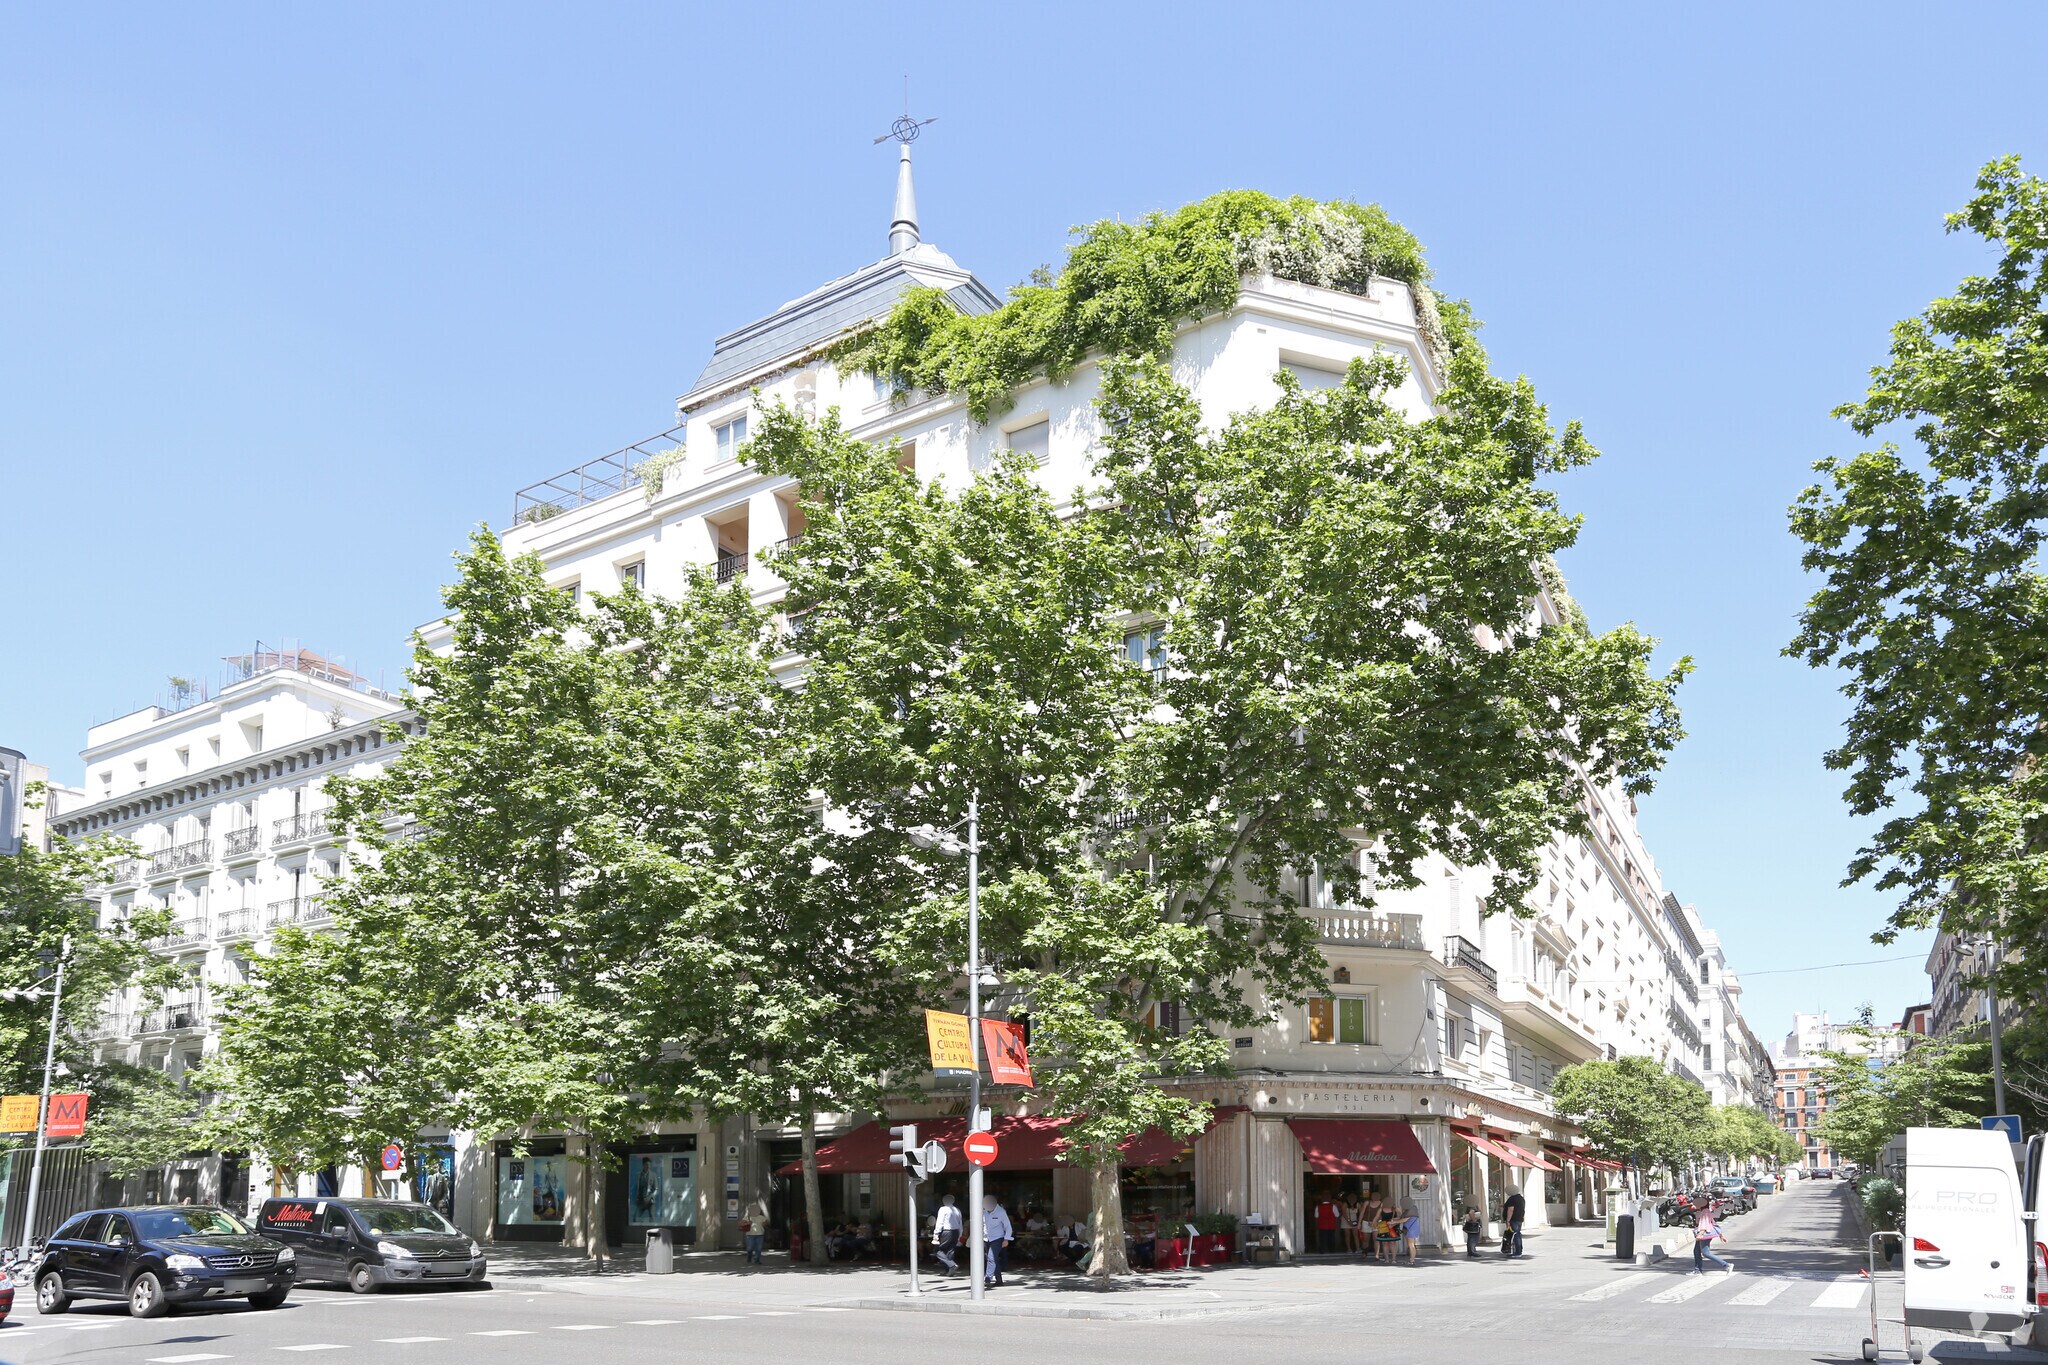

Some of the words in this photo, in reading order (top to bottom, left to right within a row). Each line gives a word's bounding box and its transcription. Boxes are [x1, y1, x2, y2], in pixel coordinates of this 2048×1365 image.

[939, 1028, 965, 1037] CENTRO
[934, 1053, 946, 1062] DE
[949, 1054, 958, 1062] LA
[1303, 1093, 1395, 1102] PASTELERIA
[1348, 1151, 1404, 1162] Mallorca
[1936, 1191, 1998, 1205] PRO
